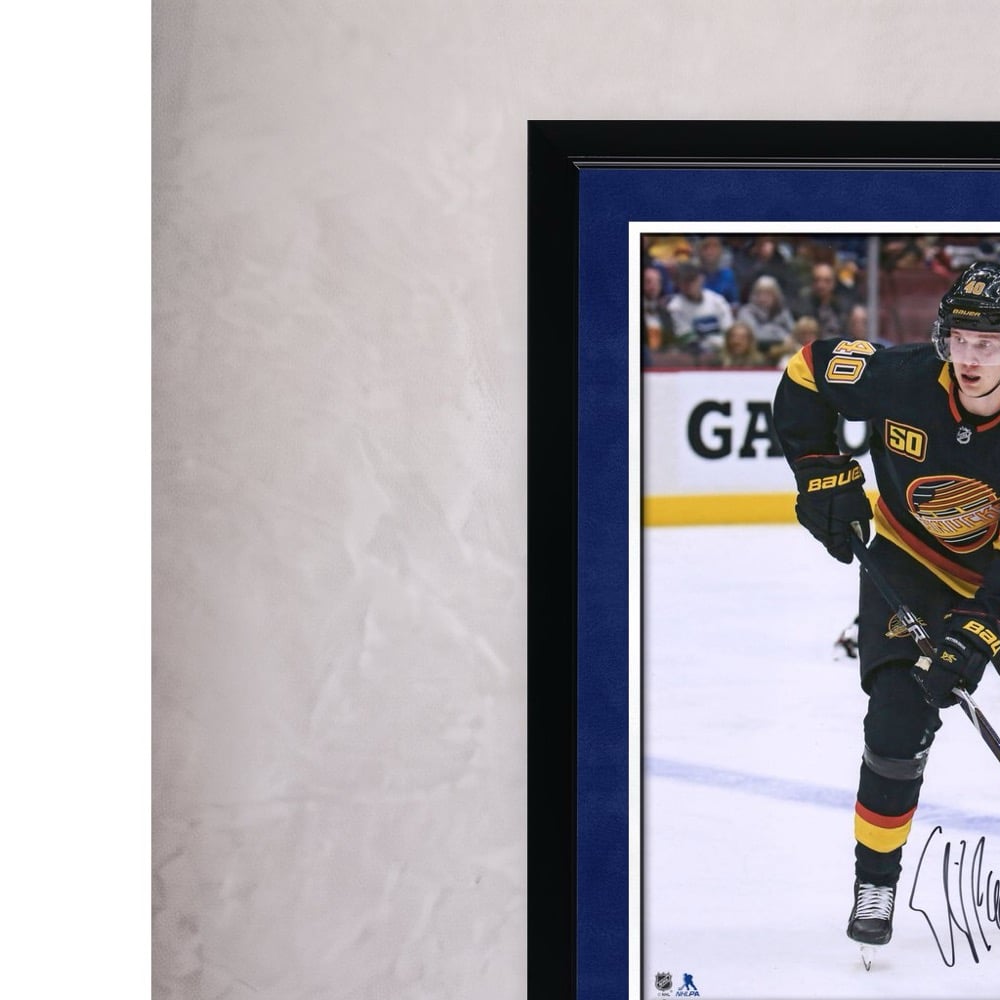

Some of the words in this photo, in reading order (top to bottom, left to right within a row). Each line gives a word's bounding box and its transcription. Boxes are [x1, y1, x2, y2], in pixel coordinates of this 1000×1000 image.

[963, 280, 986, 296] 40
[825, 340, 877, 384] 40
[889, 424, 923, 457] 50
